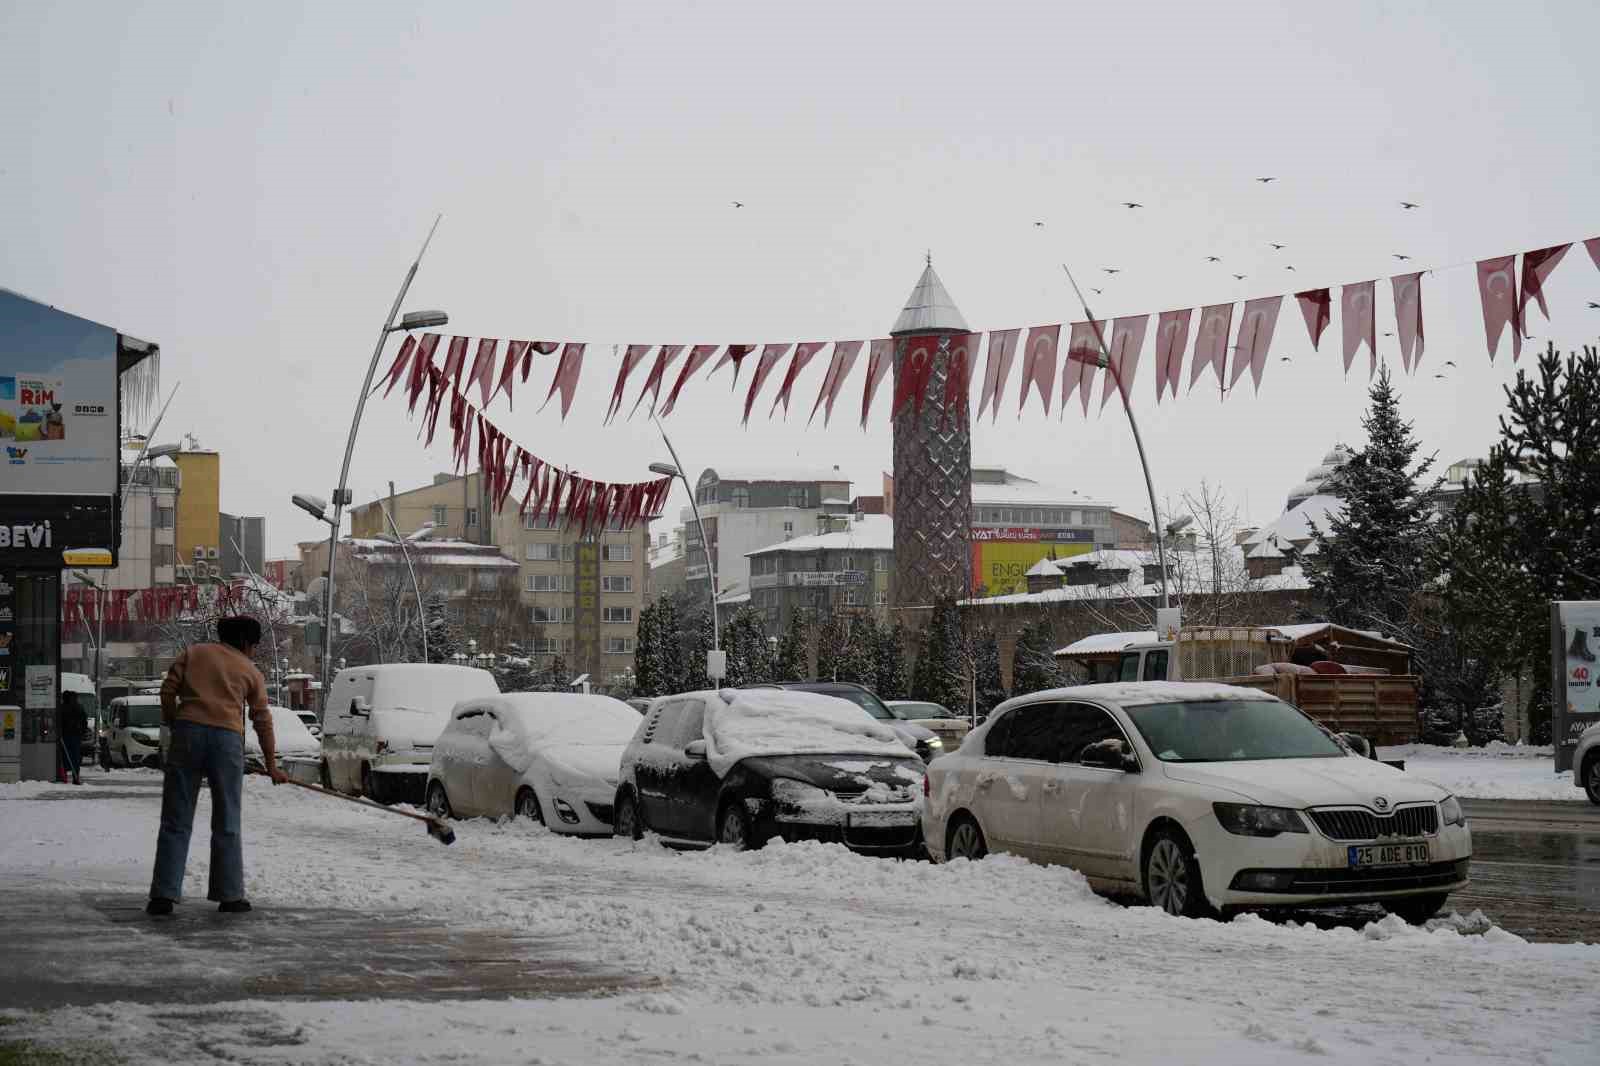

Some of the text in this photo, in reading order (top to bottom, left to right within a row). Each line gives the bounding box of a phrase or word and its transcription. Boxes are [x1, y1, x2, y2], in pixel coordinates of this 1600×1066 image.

[1358, 848, 1373, 863] 25
[1380, 846, 1401, 862] ADE
[1406, 845, 1427, 861] 810
